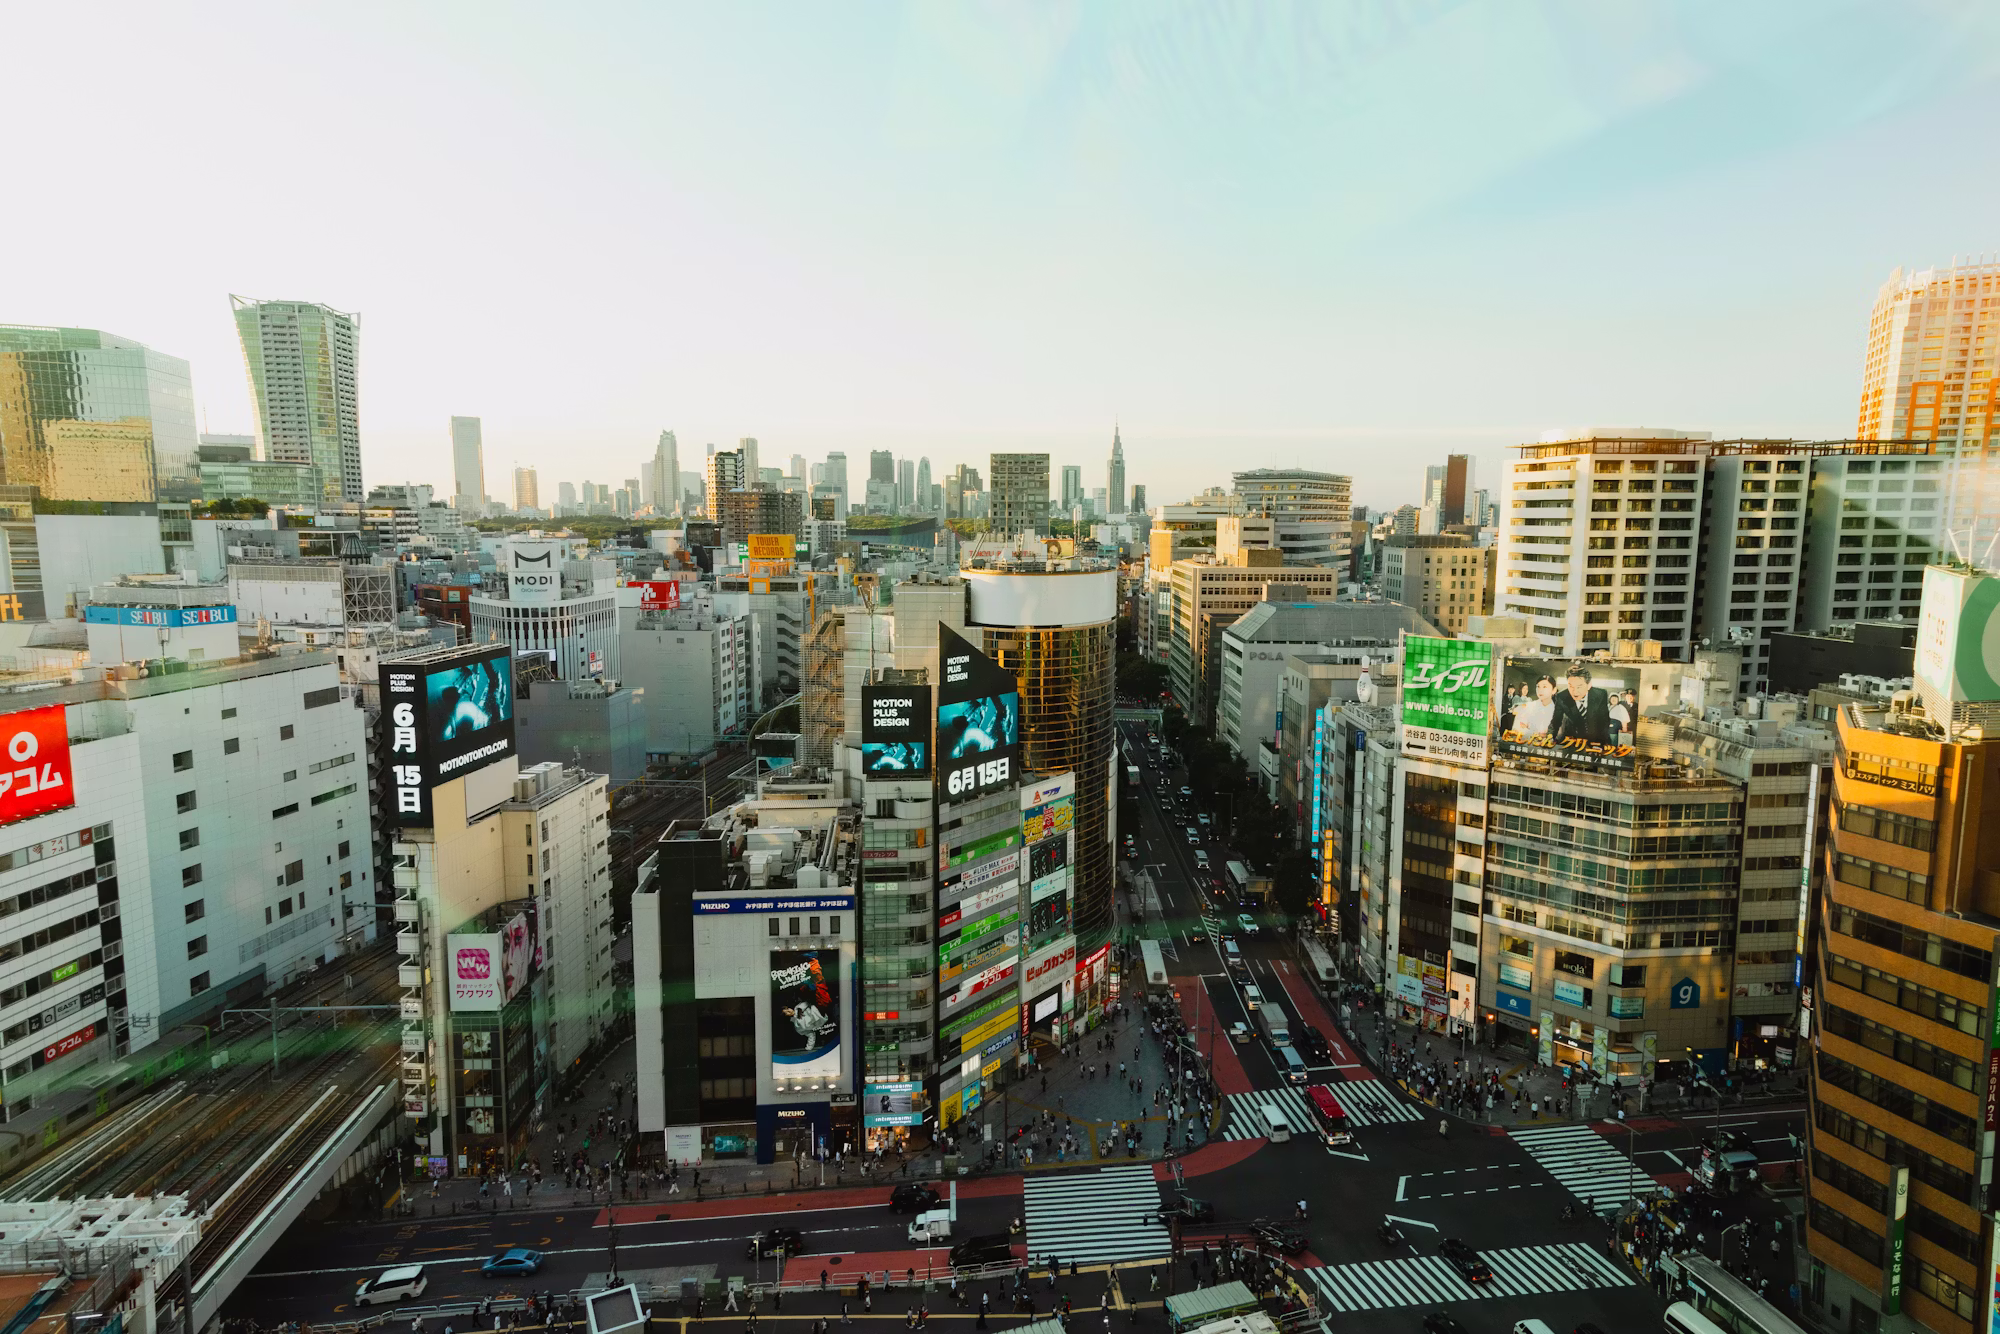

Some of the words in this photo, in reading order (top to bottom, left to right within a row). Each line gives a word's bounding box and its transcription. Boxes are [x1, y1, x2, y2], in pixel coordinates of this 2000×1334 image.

[756, 537, 779, 546] TOWER
[754, 546, 785, 556] RECORDS
[515, 575, 553, 586] MODI
[131, 611, 169, 625] SEIBU
[182, 608, 229, 625] SEIBU
[947, 655, 970, 665] MOTION
[1249, 651, 1284, 661] POLA
[947, 665, 962, 674] PLUS
[1403, 660, 1490, 693] エイブル
[389, 673, 416, 681] MOTION
[947, 672, 968, 683] DESIGN
[873, 699, 912, 708] MOTION
[1405, 701, 1484, 720] www.able.co.jp
[873, 709, 898, 718] PLUS
[873, 718, 909, 727] DESIGN
[1405, 729, 1427, 740] 渋谷店
[1429, 732, 1483, 748] 03-3499-8911
[1502, 728, 1557, 749] にしたん
[1560, 735, 1635, 758] クリニック
[439, 738, 508, 774] MOTIONTOKYO.COM
[1429, 745, 1468, 759] 当ビル向側
[1469, 752, 1483, 761] 4F
[1857, 772, 1899, 786] エステティック
[1900, 780, 1916, 791] ミス
[700, 902, 731, 910] MIZUHO
[745, 902, 774, 910] みずほ銀行
[777, 900, 817, 909] みずほ信託銀行
[819, 899, 849, 908] みずほ証券
[1026, 945, 1075, 983] ビックカメラ
[983, 973, 1002, 989] アコム
[456, 989, 493, 998] ワクワク
[1679, 985, 1693, 1005] g
[1022, 1003, 1030, 1033] カラオケ
[60, 1035, 82, 1053] アコム
[85, 1028, 95, 1038] 3F
[983, 1060, 999, 1074] プロミス
[1986, 1056, 1999, 1122] 三井のリハウス
[777, 1110, 806, 1118] MIZUHO
[1891, 1239, 1903, 1297] りそな銀行
